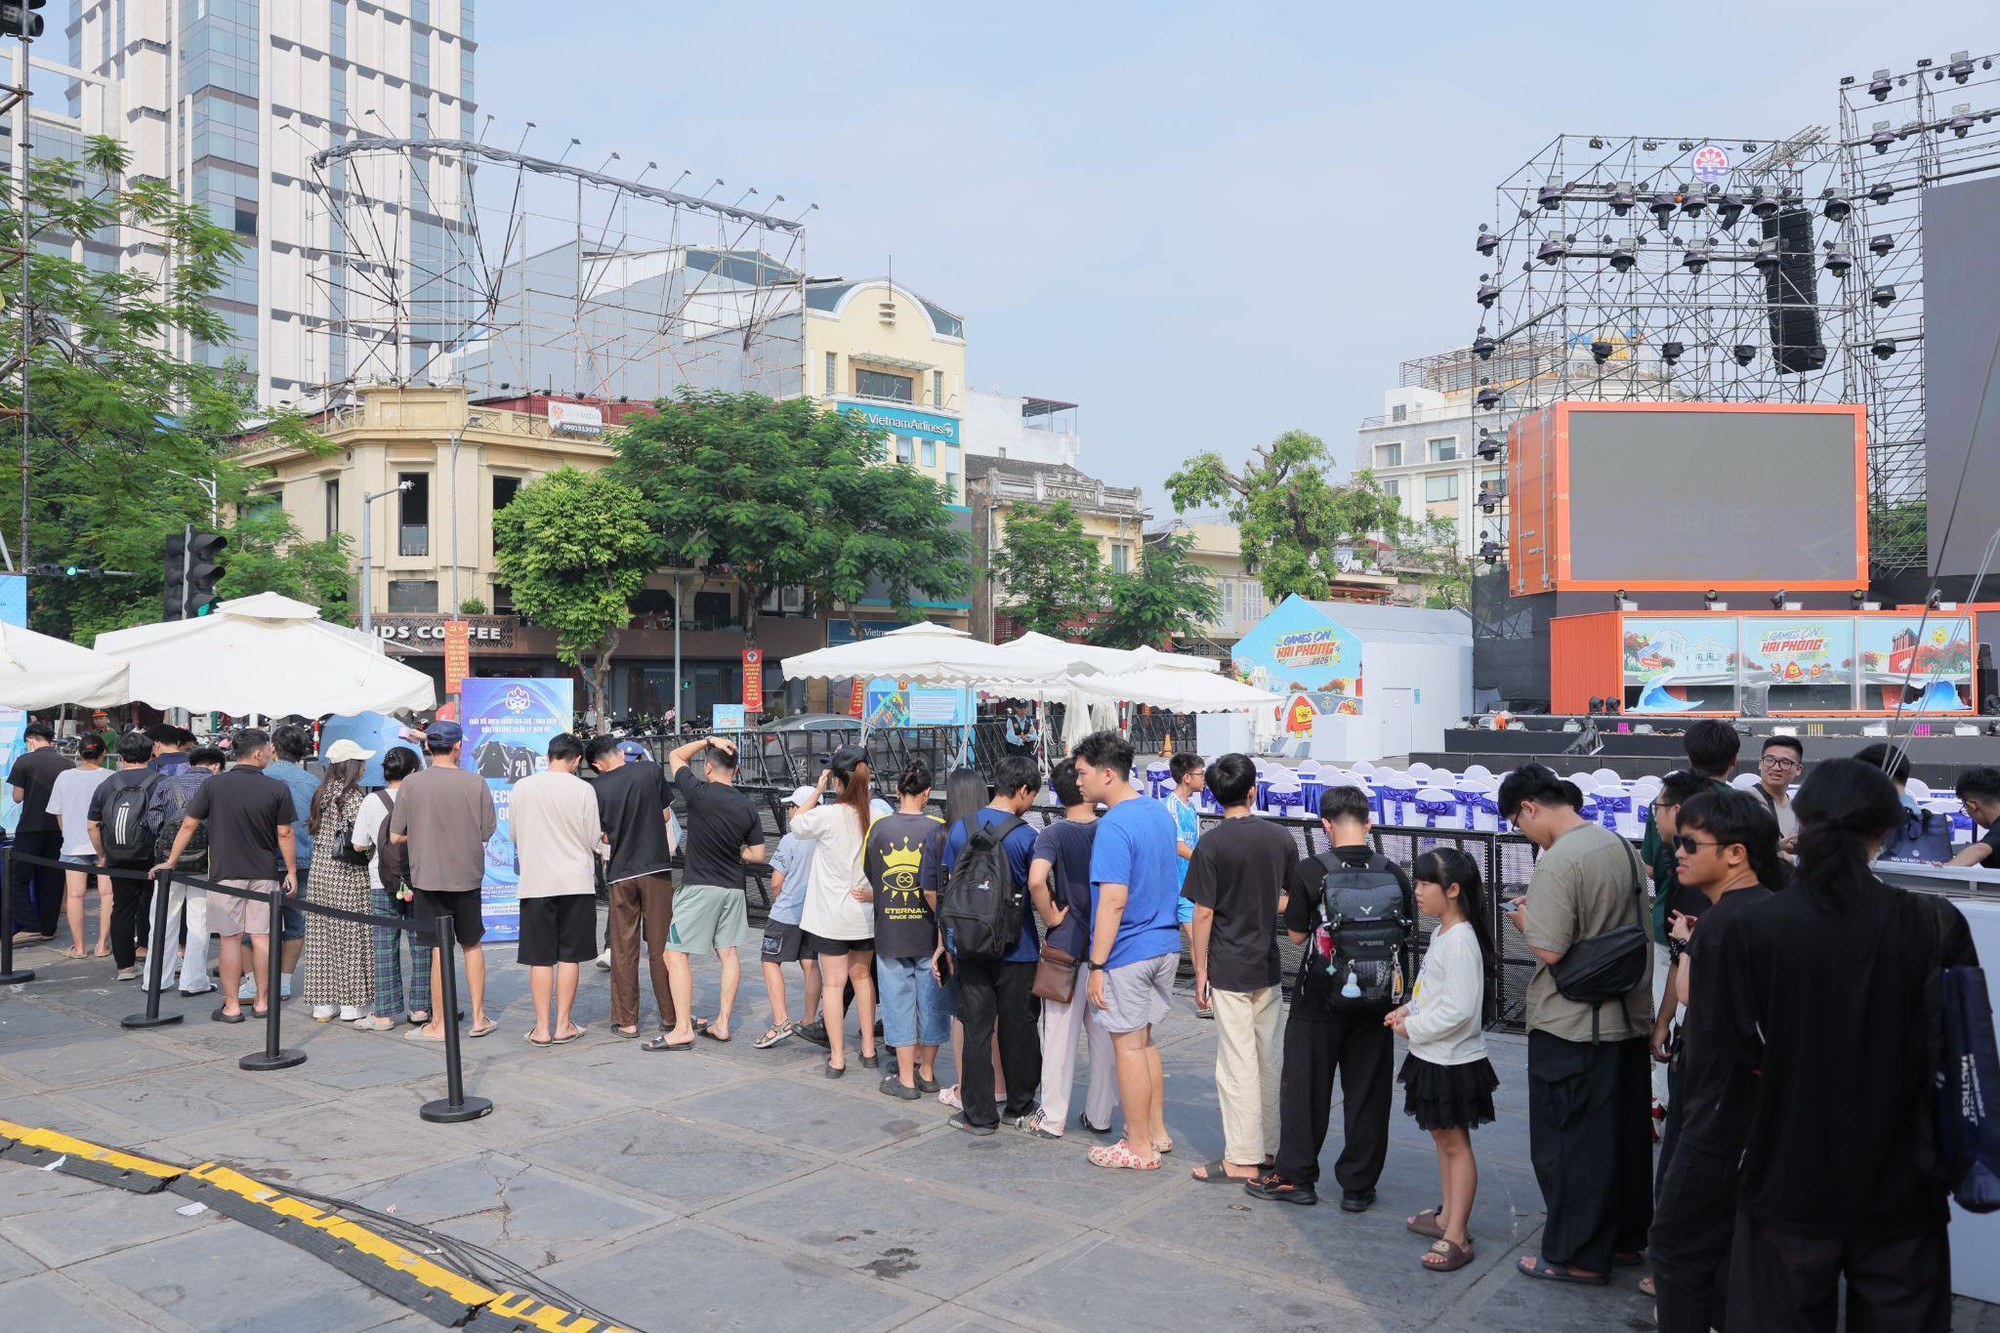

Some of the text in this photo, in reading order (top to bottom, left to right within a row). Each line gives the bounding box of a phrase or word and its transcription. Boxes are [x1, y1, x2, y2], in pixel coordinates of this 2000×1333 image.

[868, 413, 943, 434] Vietnam Airlines
[416, 626, 501, 640] COFEE
[1283, 630, 1332, 646] GAMES ON
[1769, 627, 1820, 641] GAMES ON
[515, 760, 527, 777] 26
